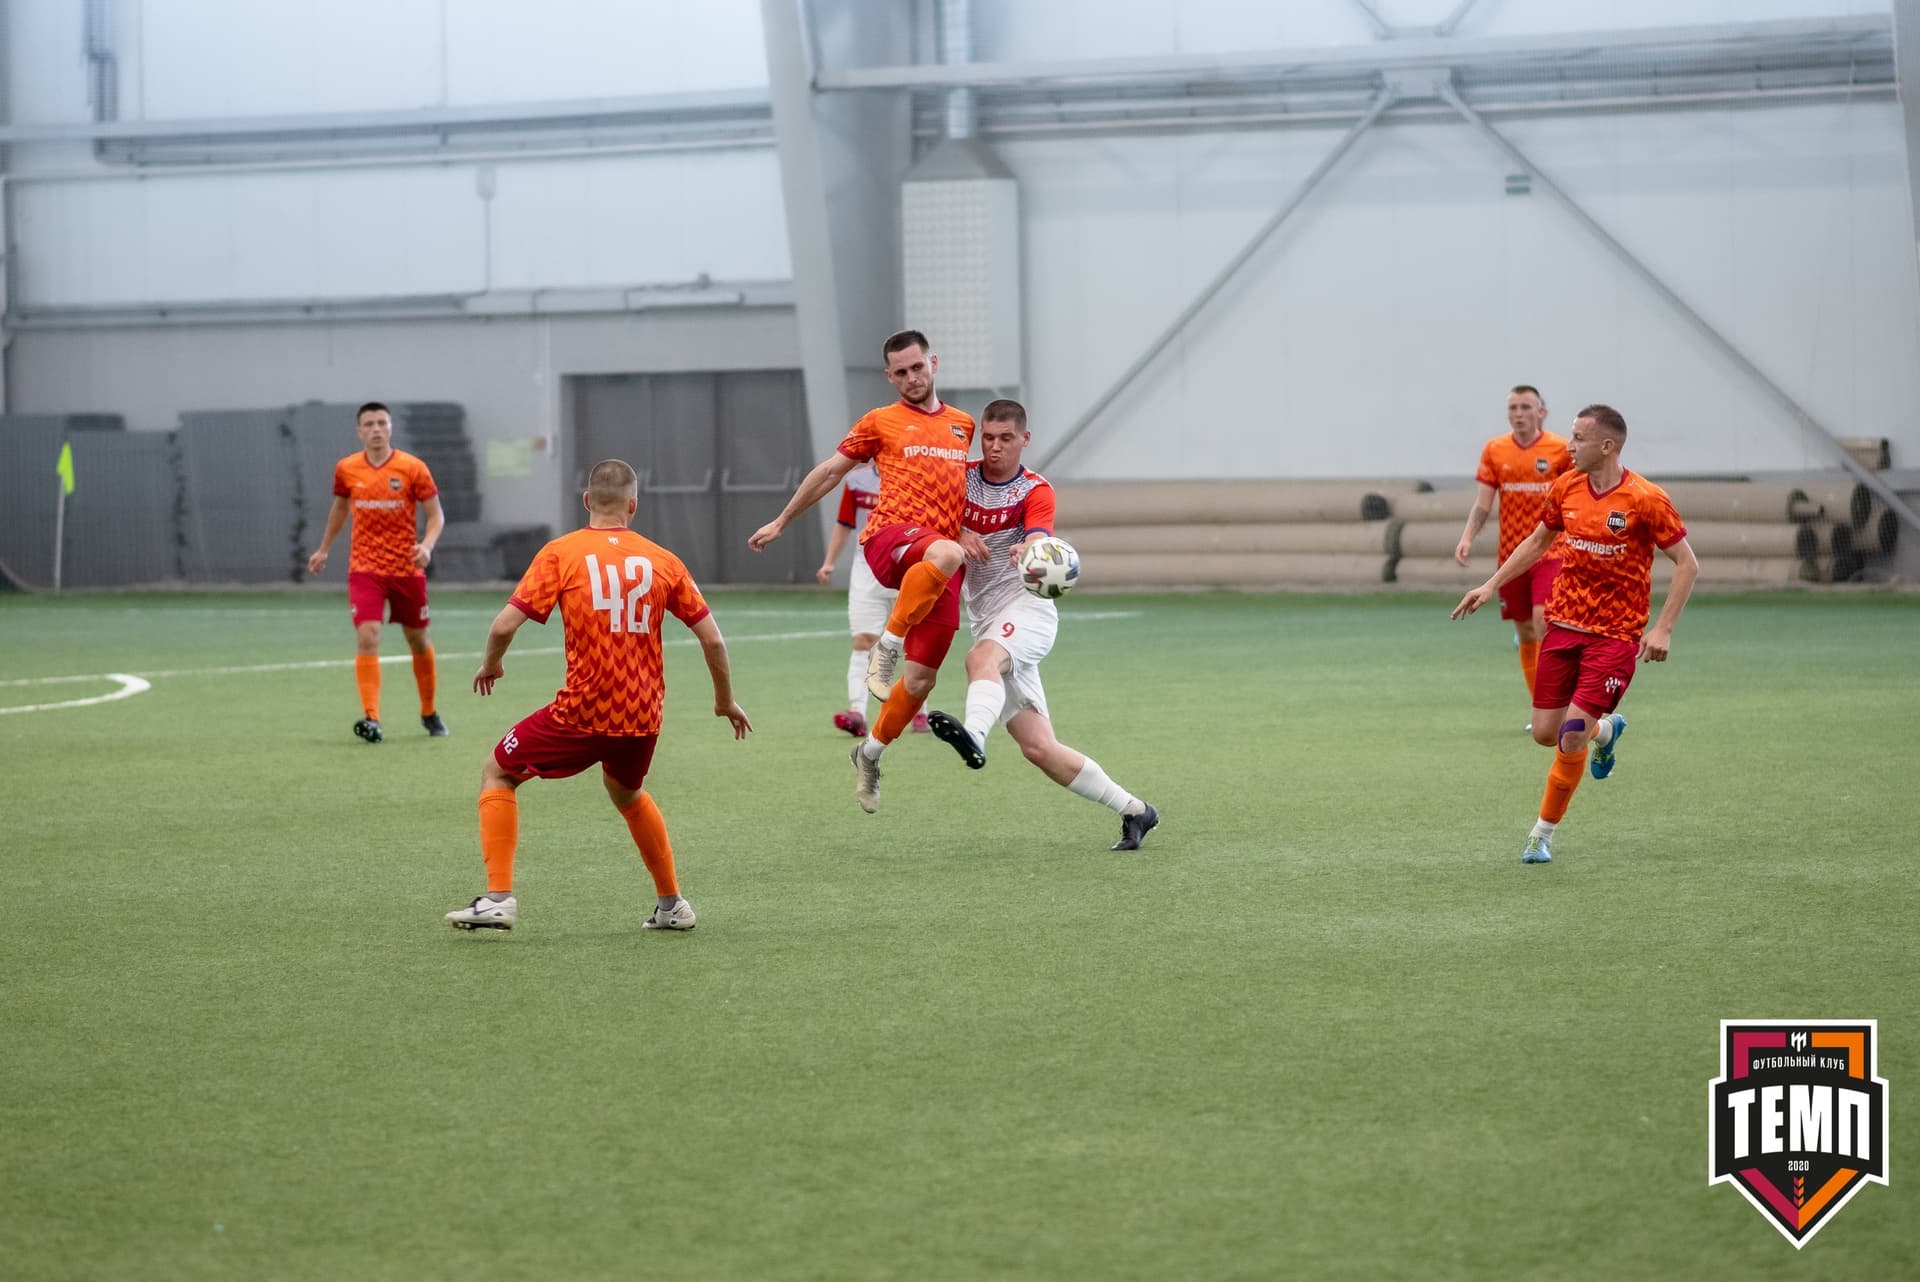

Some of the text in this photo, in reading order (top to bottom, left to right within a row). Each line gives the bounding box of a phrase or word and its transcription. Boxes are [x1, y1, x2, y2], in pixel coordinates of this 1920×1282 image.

[904, 445, 967, 461] ПРОДИНВЕС
[585, 554, 653, 634] 42
[1002, 622, 1015, 638] 9
[503, 727, 519, 755] 42
